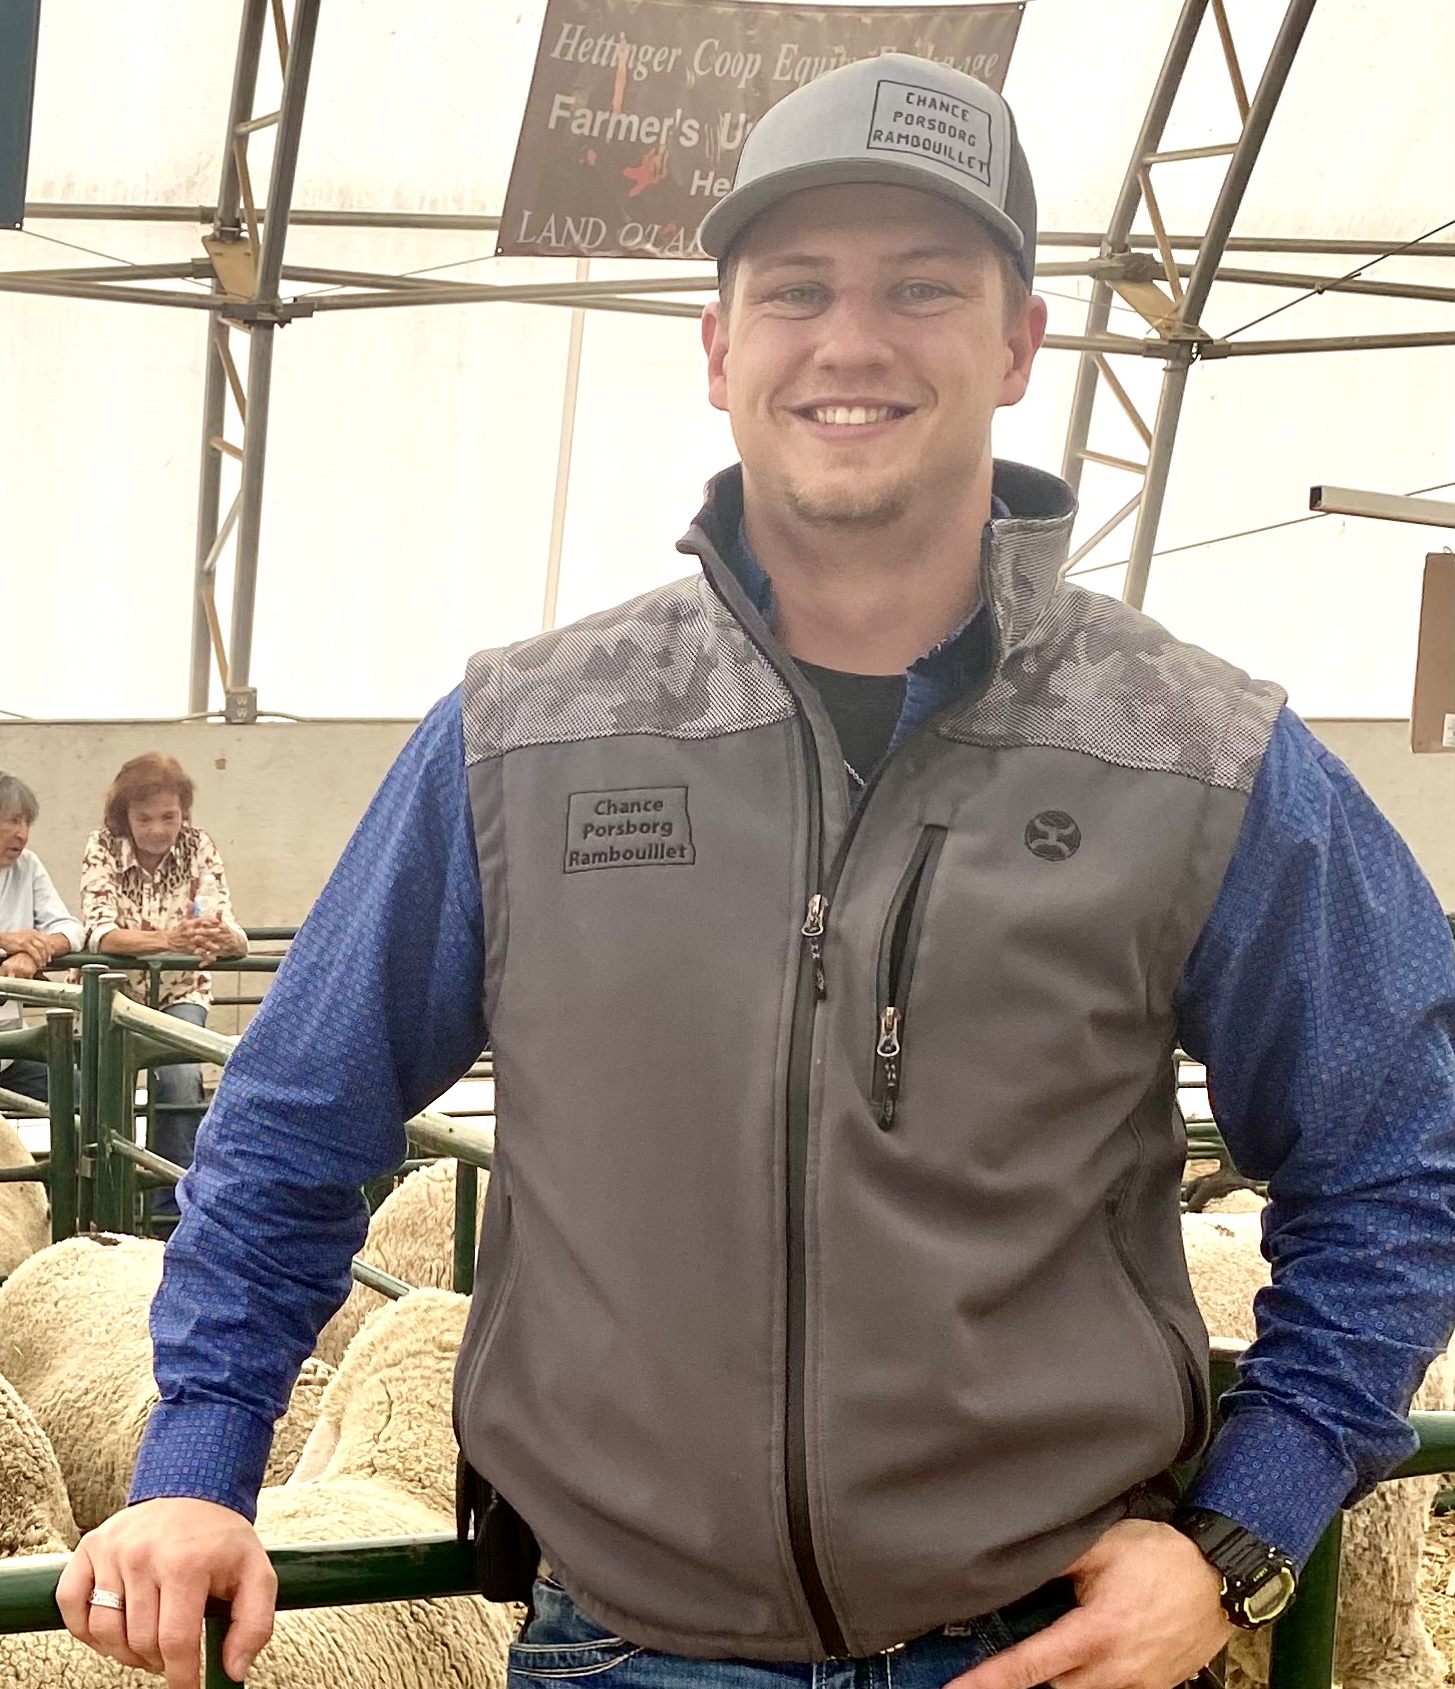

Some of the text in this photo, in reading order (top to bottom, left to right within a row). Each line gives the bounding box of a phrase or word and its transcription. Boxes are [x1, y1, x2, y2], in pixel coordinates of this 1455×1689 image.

[549, 22, 682, 81] Hettinger
[692, 37, 762, 89] Coop
[547, 92, 700, 148] Farmer's
[905, 92, 970, 122] CHANCE
[892, 110, 977, 147] PORSBORG
[872, 129, 988, 174] RAMBOUILLET
[516, 209, 608, 248] LAND
[593, 799, 664, 816] Chance
[582, 819, 674, 841] Porsborg
